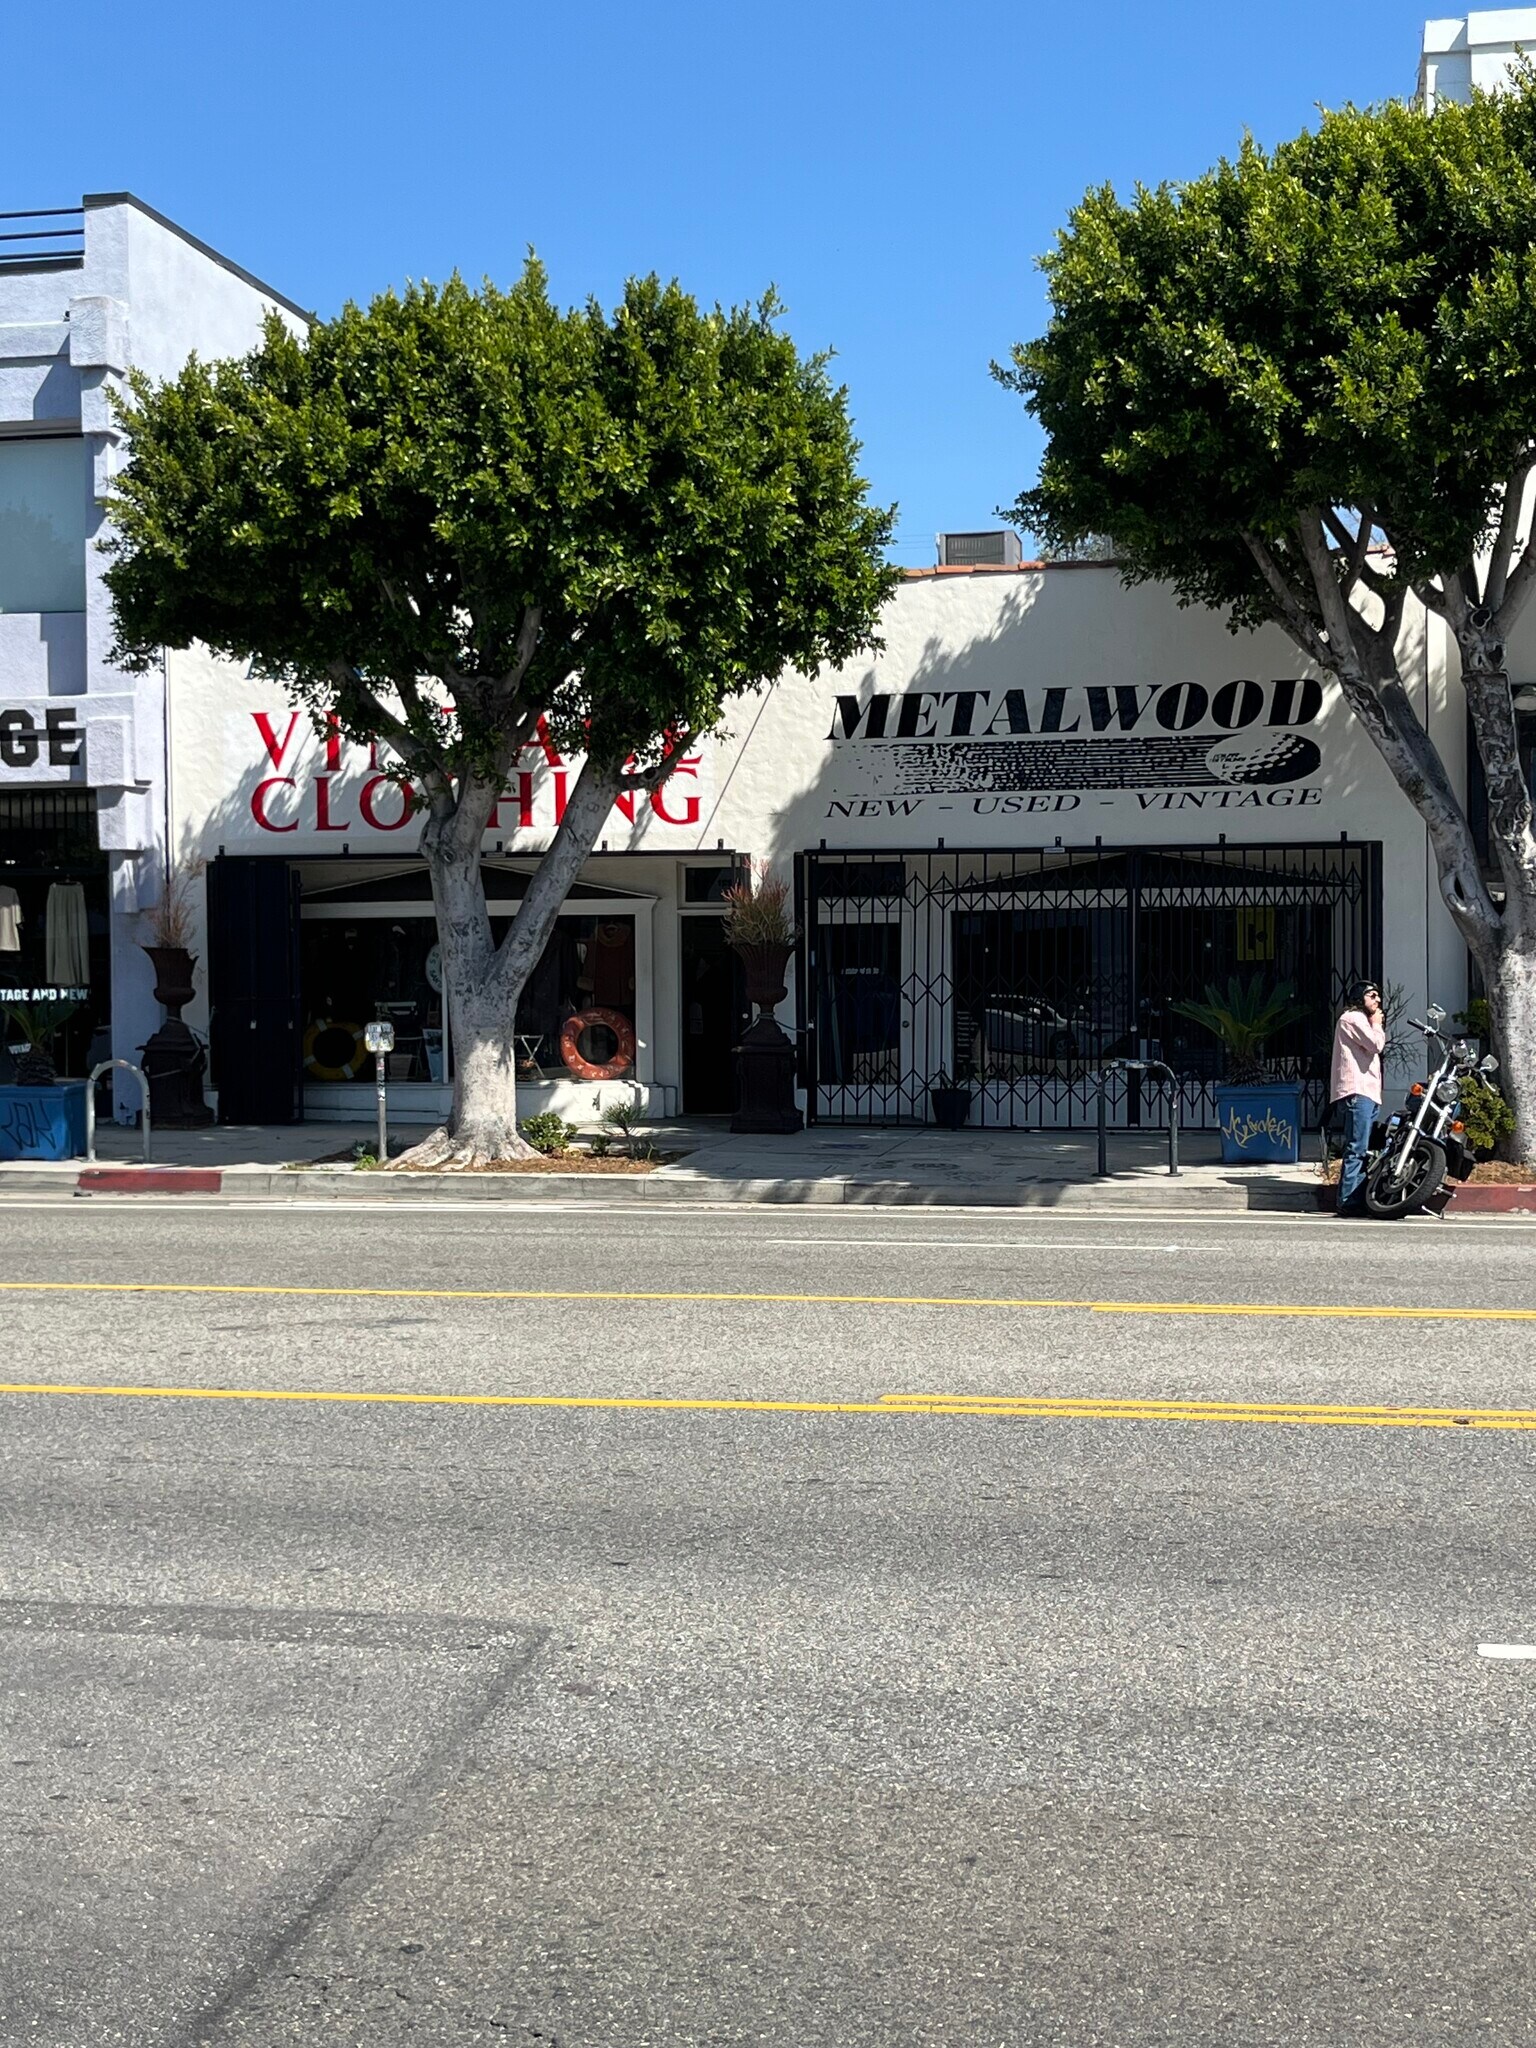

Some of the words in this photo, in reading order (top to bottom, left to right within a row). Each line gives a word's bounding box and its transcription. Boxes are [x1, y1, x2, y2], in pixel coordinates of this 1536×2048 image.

[823, 679, 1323, 741] METALWOOD
[824, 799, 925, 818] NEW
[972, 794, 1081, 815] USED
[1136, 788, 1323, 810] VINTAGE
[32, 988, 57, 1001] AND
